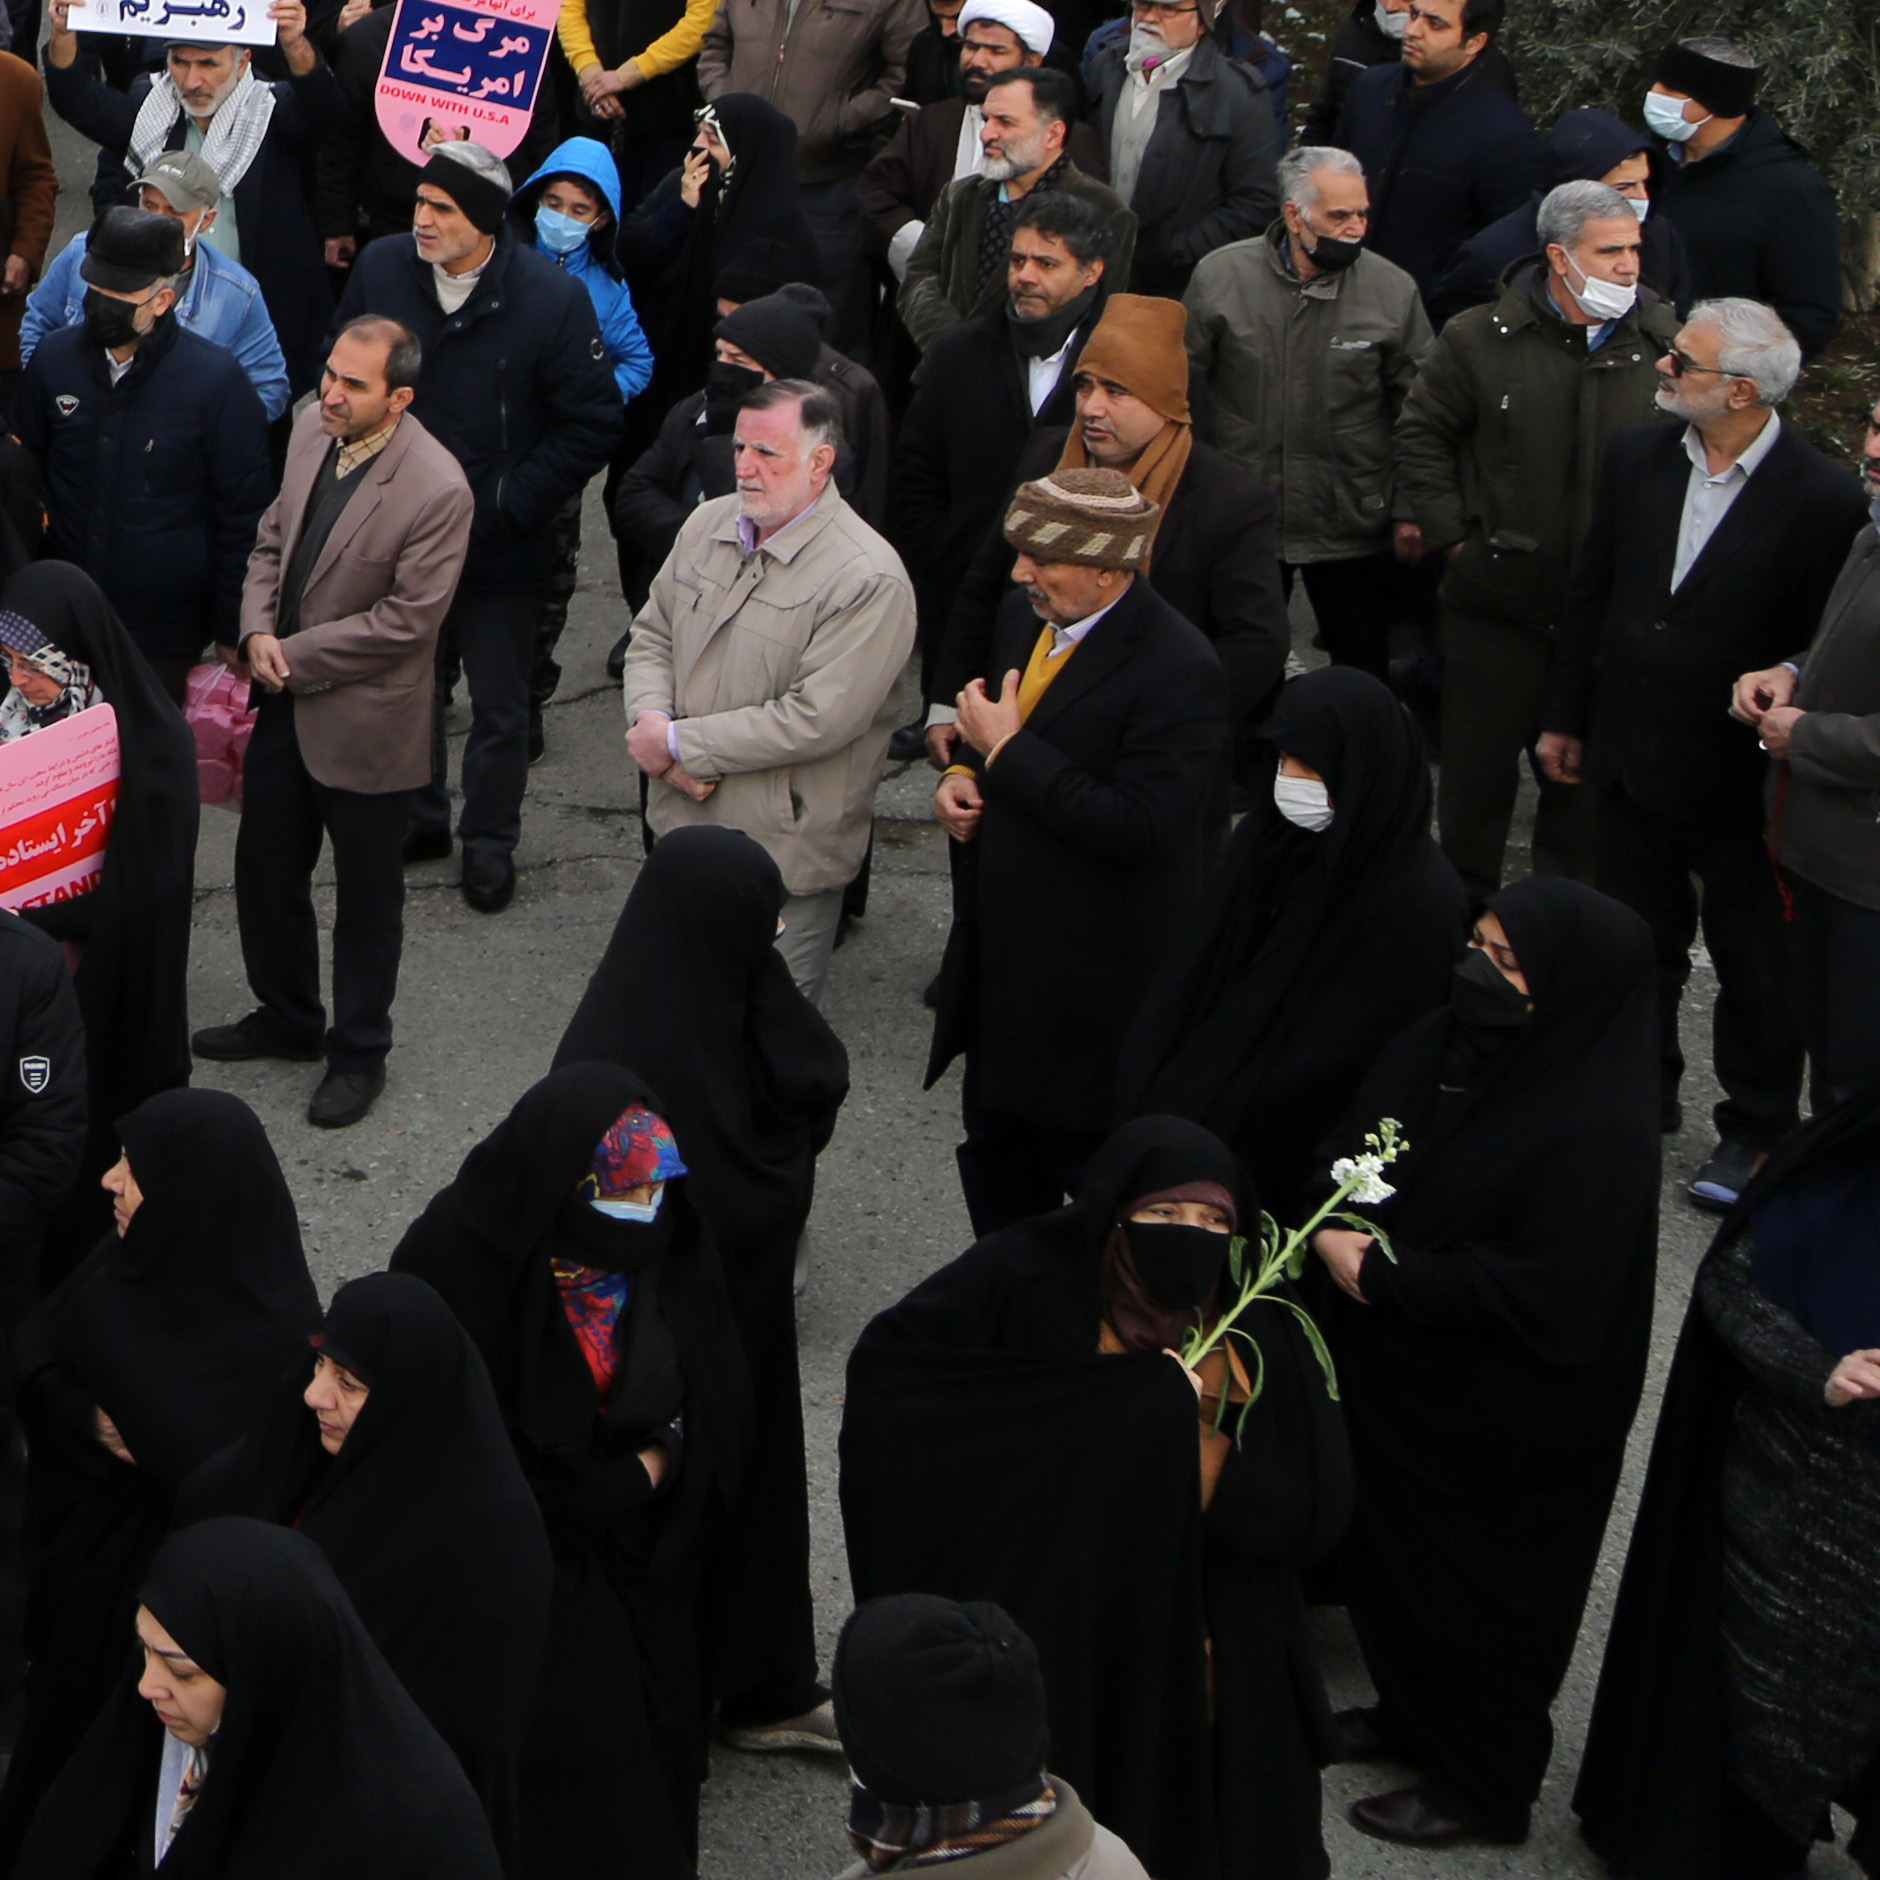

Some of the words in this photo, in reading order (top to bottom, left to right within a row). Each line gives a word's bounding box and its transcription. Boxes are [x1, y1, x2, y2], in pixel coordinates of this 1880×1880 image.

[409, 13, 445, 41] بر
[452, 17, 531, 59] مرگ
[400, 42, 526, 99] امریکا
[379, 84, 427, 104] DOWN
[431, 96, 469, 116] WITH
[472, 106, 510, 126] U.S.A
